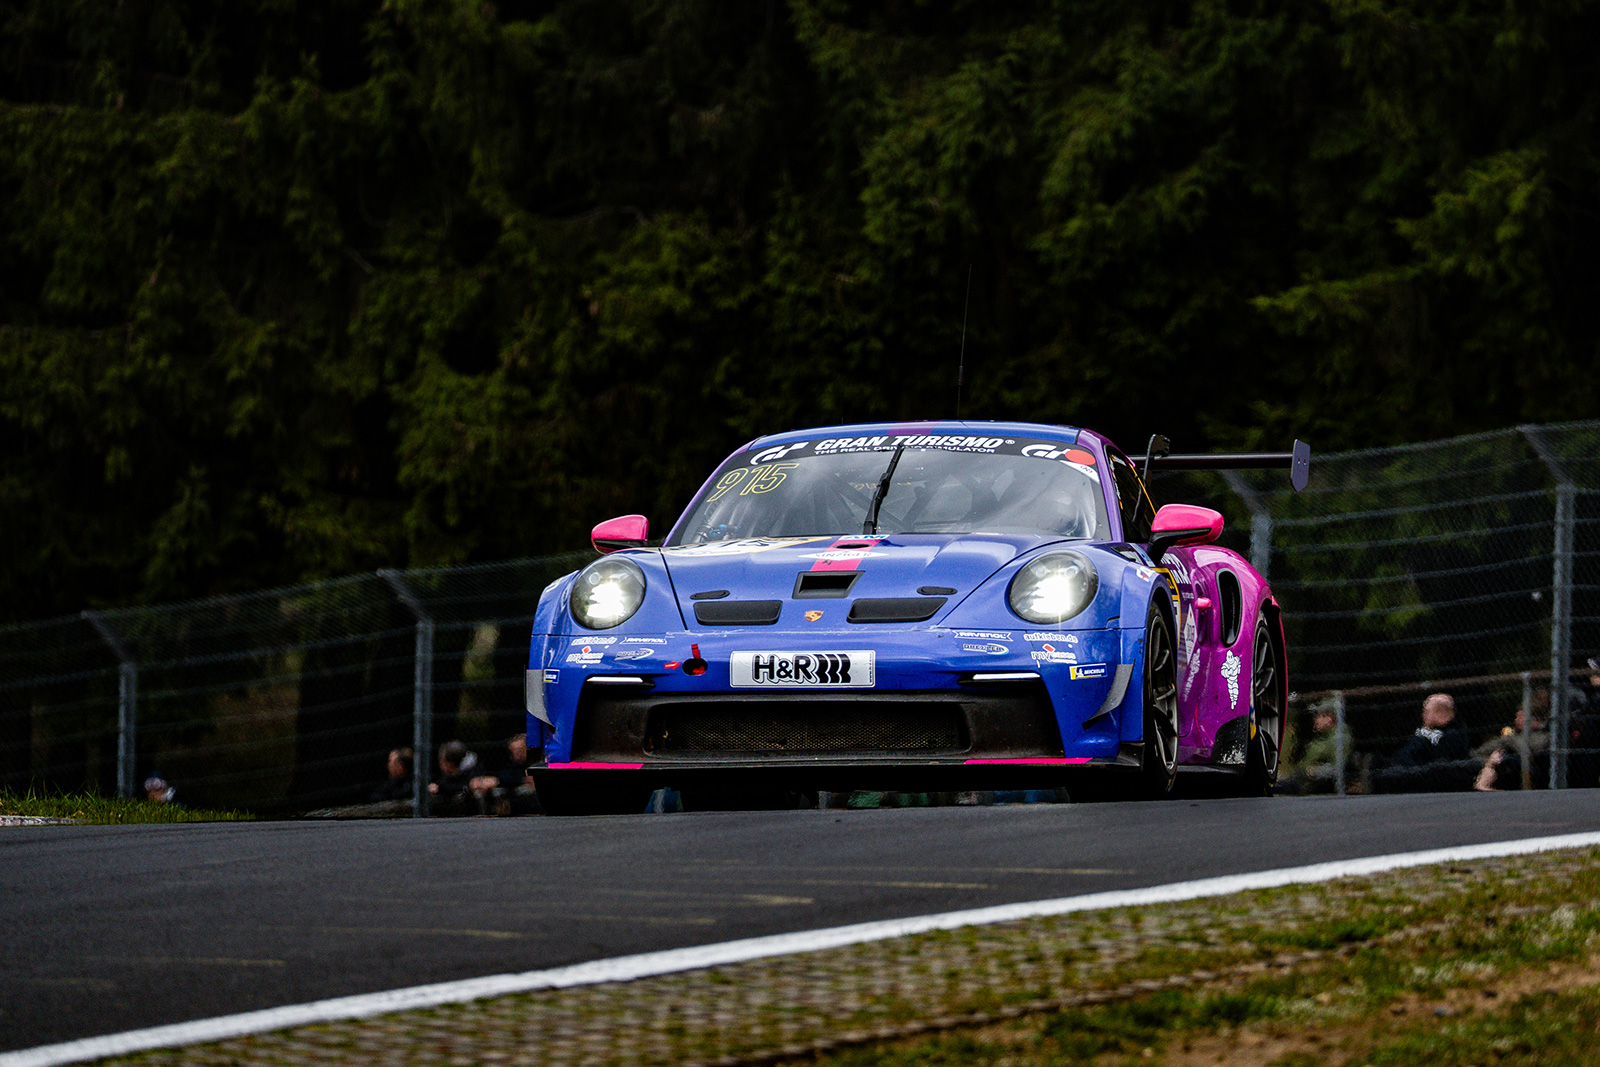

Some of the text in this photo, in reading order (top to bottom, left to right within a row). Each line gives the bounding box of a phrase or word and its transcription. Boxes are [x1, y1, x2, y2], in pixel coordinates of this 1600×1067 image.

[814, 436, 889, 451] GRAN
[706, 462, 800, 503] 915
[753, 654, 814, 682] H&R
